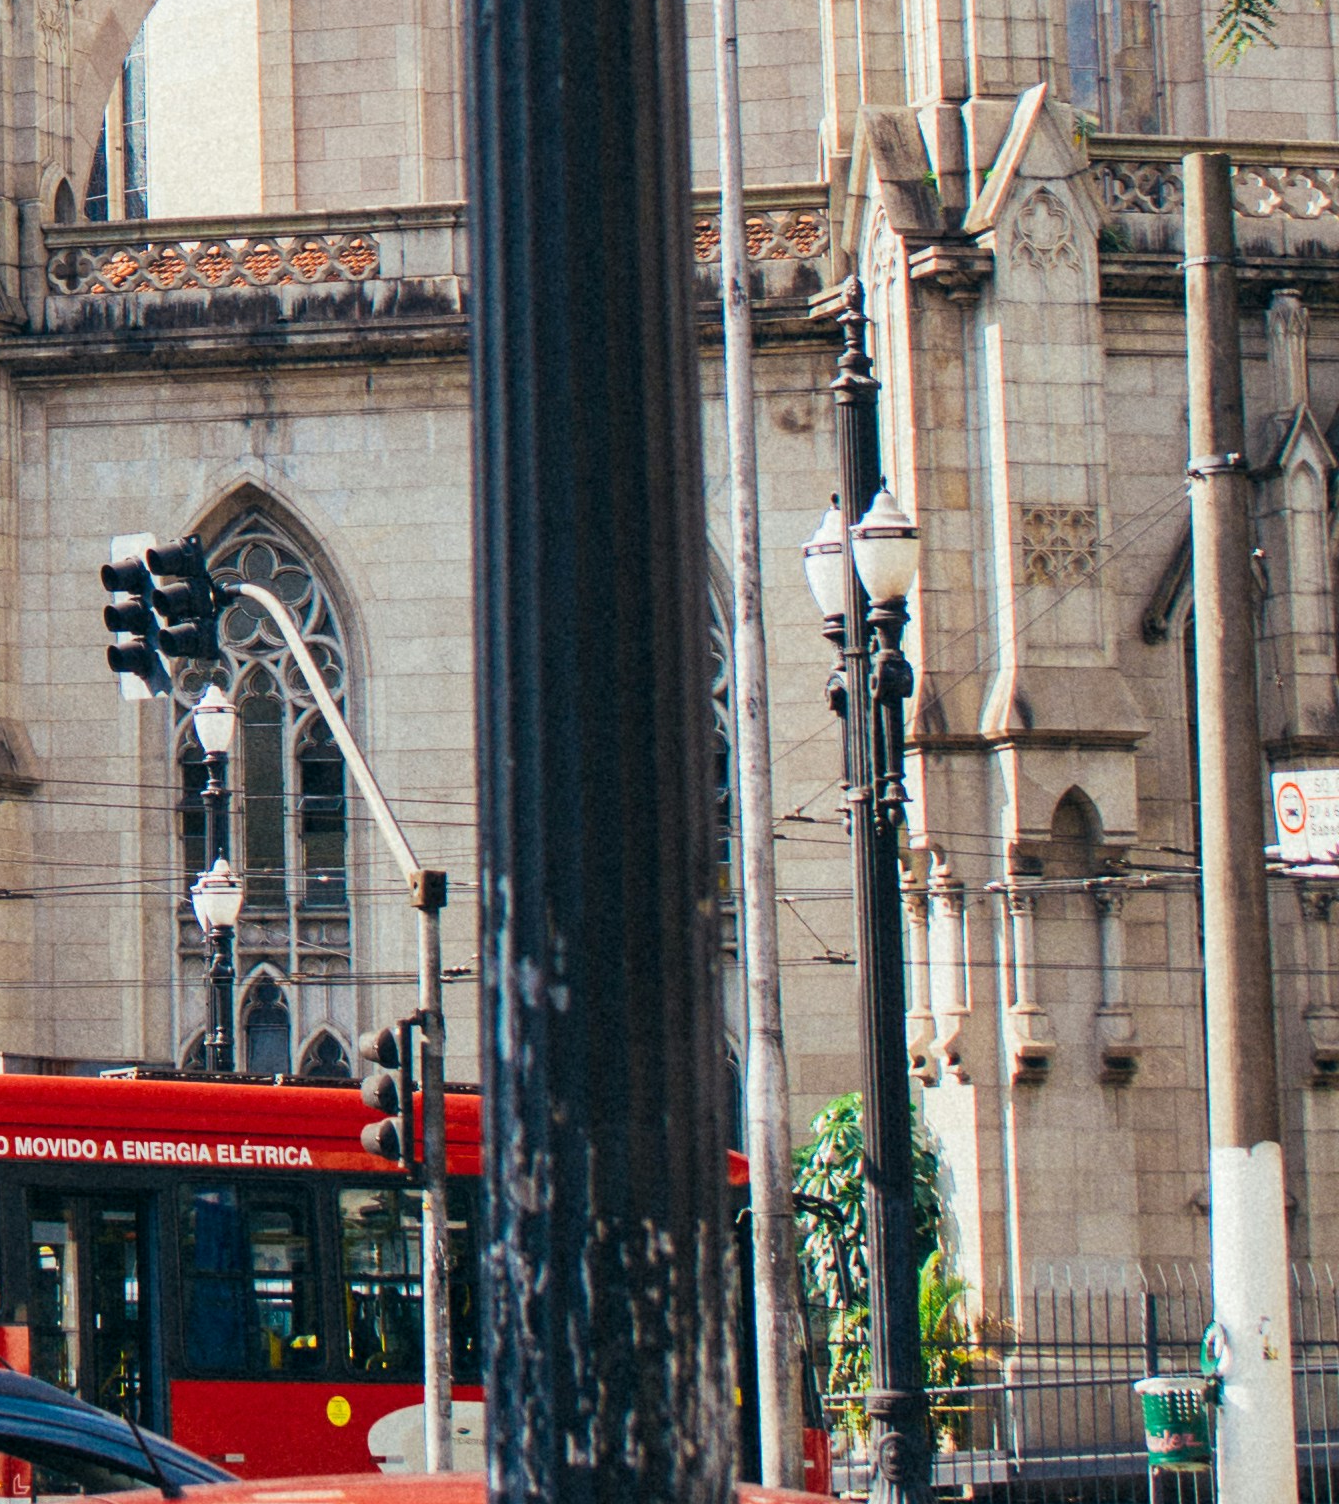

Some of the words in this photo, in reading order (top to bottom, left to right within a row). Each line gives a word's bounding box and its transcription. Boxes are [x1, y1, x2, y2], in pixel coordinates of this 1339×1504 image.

[15, 1137, 97, 1159] MOVIDO
[103, 1141, 117, 1159] A
[122, 1140, 211, 1163] ENERGIA
[217, 1139, 312, 1166] ELÉTRICA
